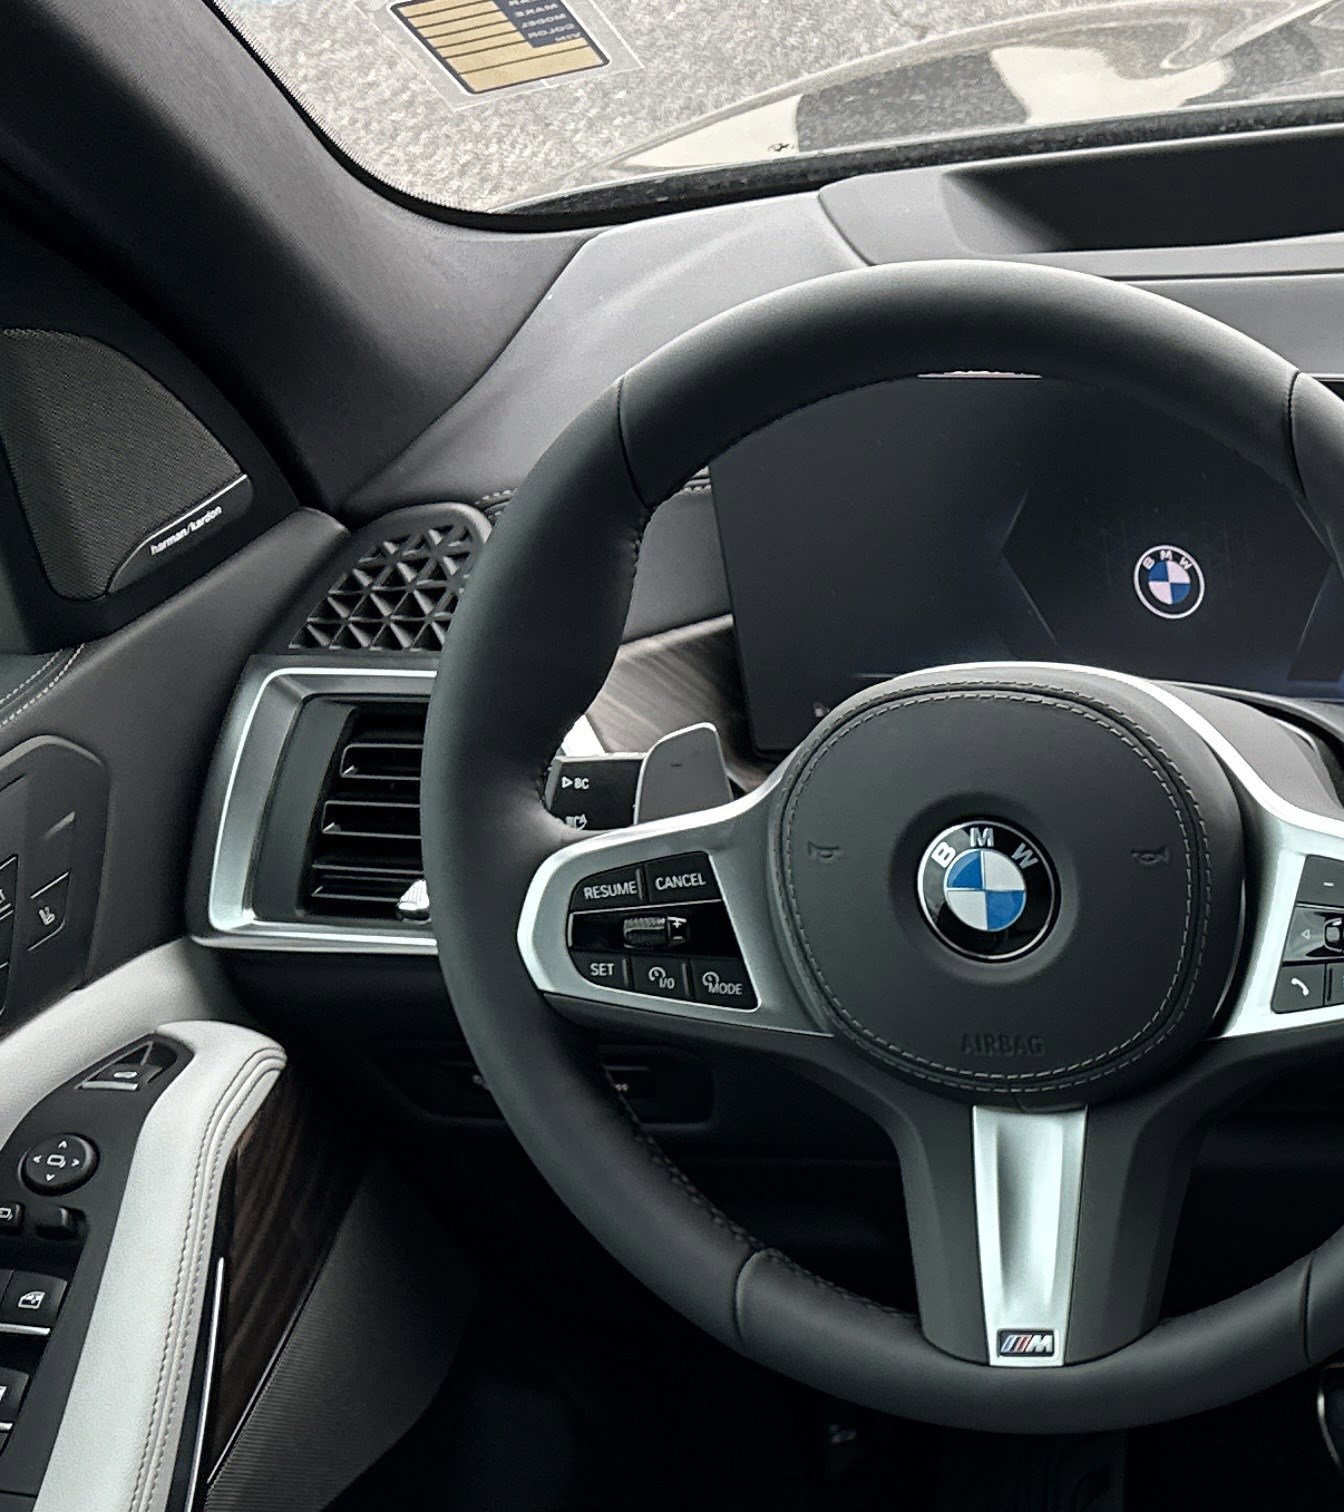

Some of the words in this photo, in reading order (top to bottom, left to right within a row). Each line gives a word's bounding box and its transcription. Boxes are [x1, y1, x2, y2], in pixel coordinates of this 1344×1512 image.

[1142, 550, 1193, 570] BMW
[574, 777, 589, 790] BC
[931, 827, 1039, 869] BMW
[583, 881, 638, 899] RESUME
[655, 873, 706, 890] CANCEL
[590, 963, 614, 976] SET
[708, 982, 743, 995] MODE
[961, 1032, 1046, 1057] AIRBAG
